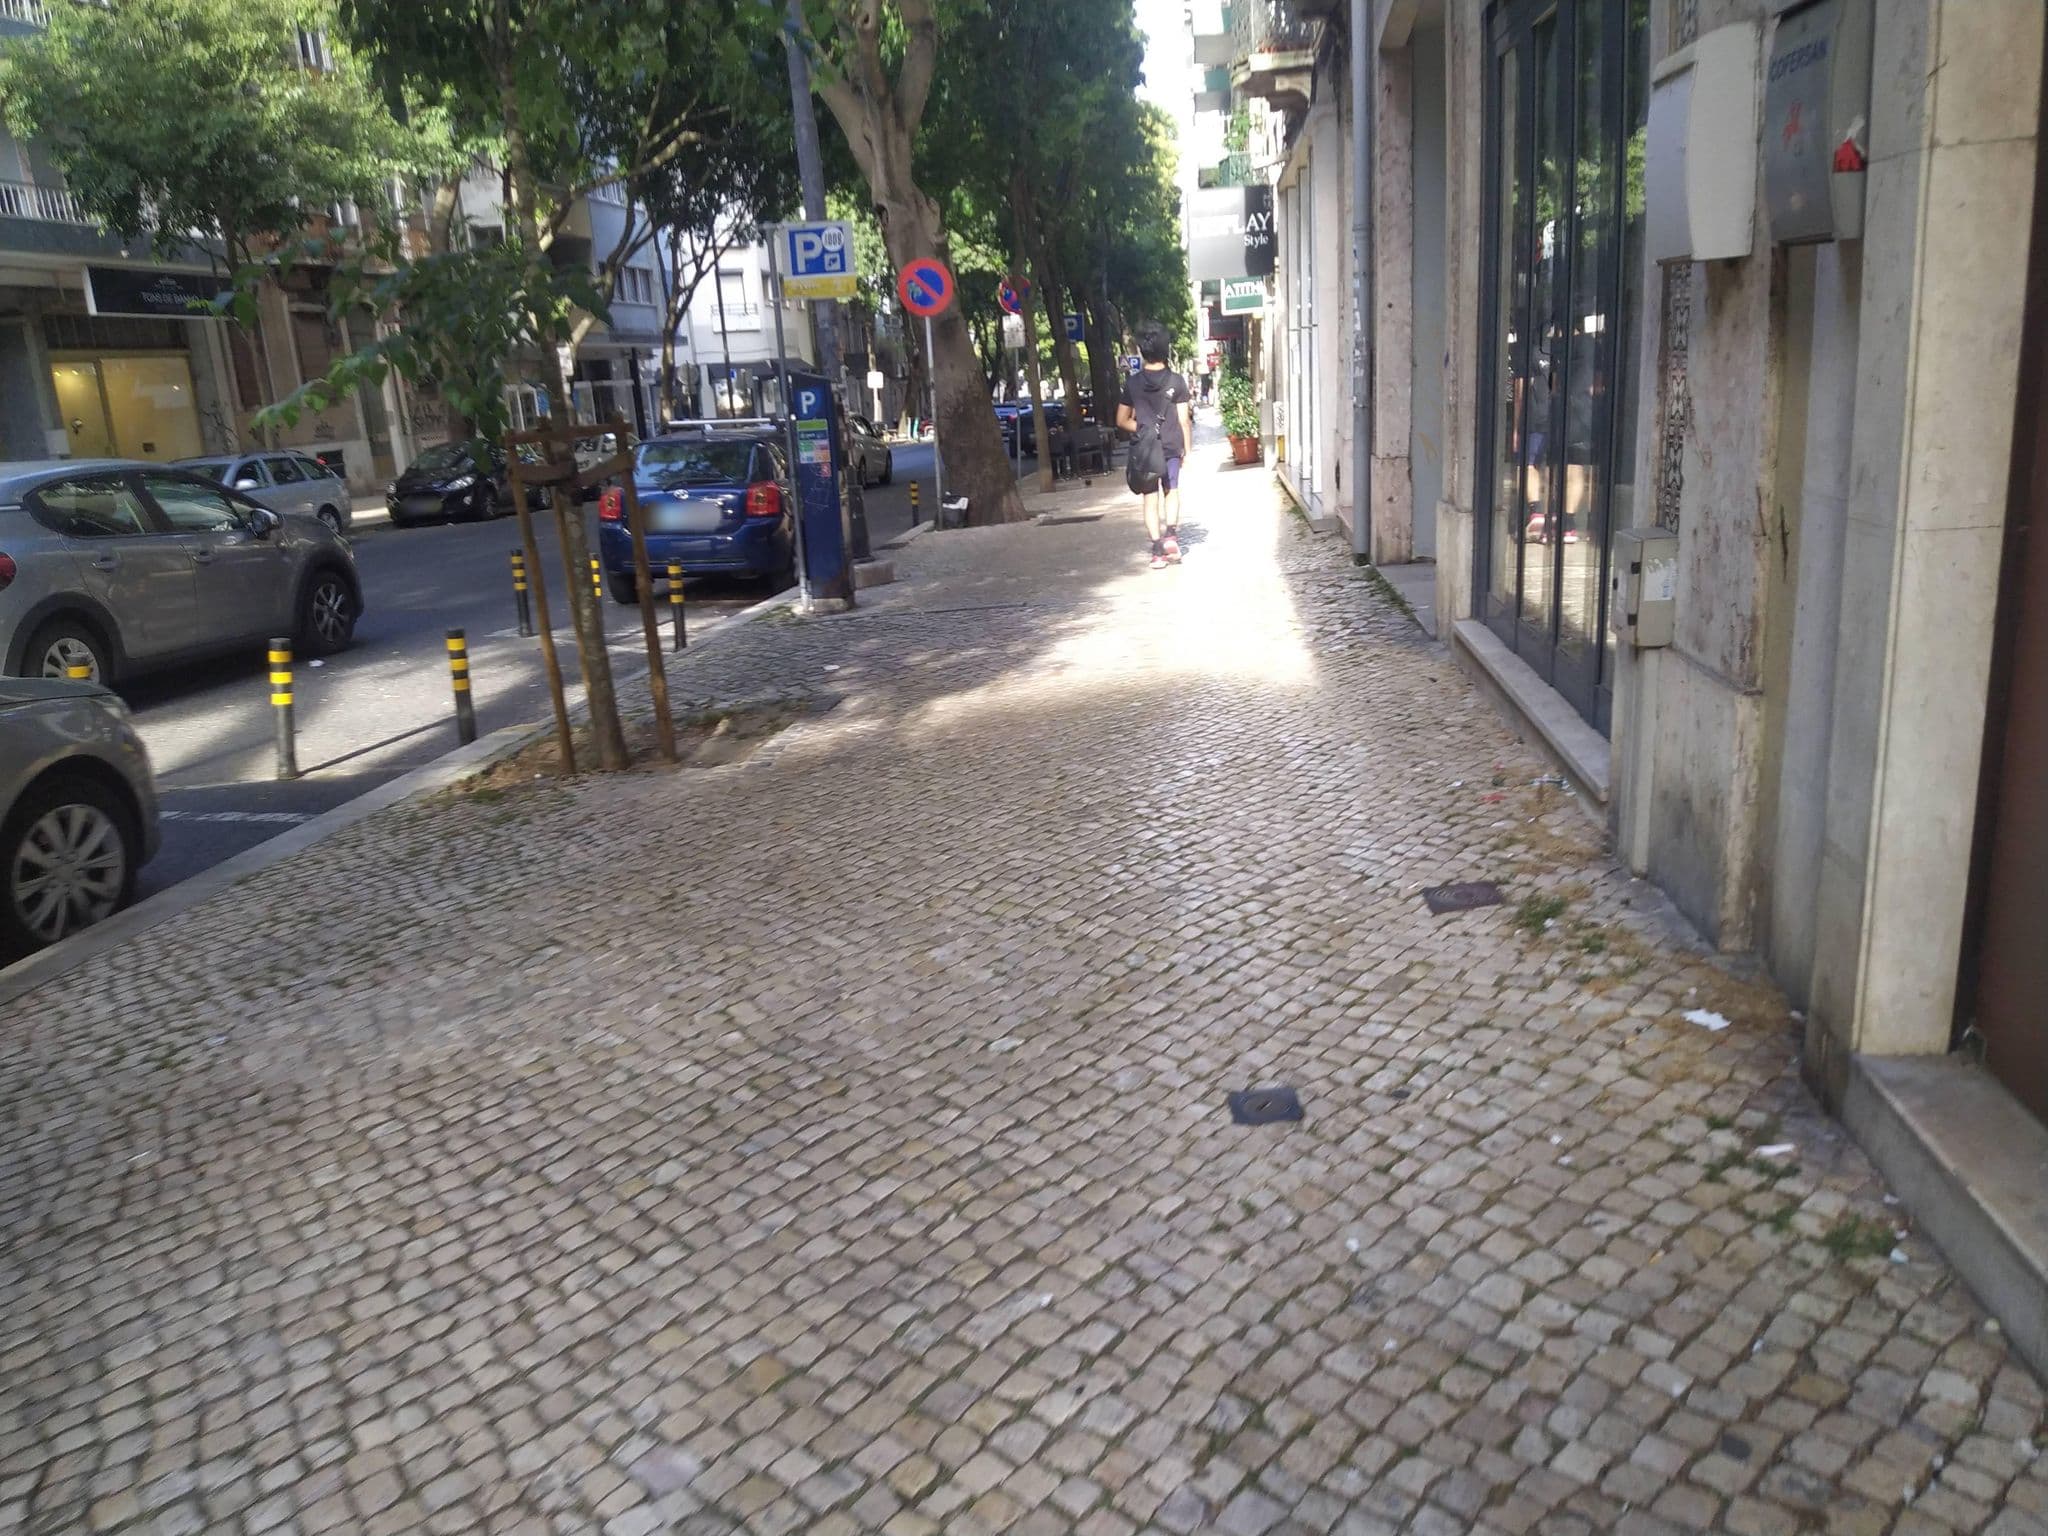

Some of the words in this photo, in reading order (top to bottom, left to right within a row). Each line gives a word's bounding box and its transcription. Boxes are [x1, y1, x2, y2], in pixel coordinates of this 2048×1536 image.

[1244, 233, 1269, 248] Style
[794, 232, 823, 273] P
[801, 391, 816, 414] P
